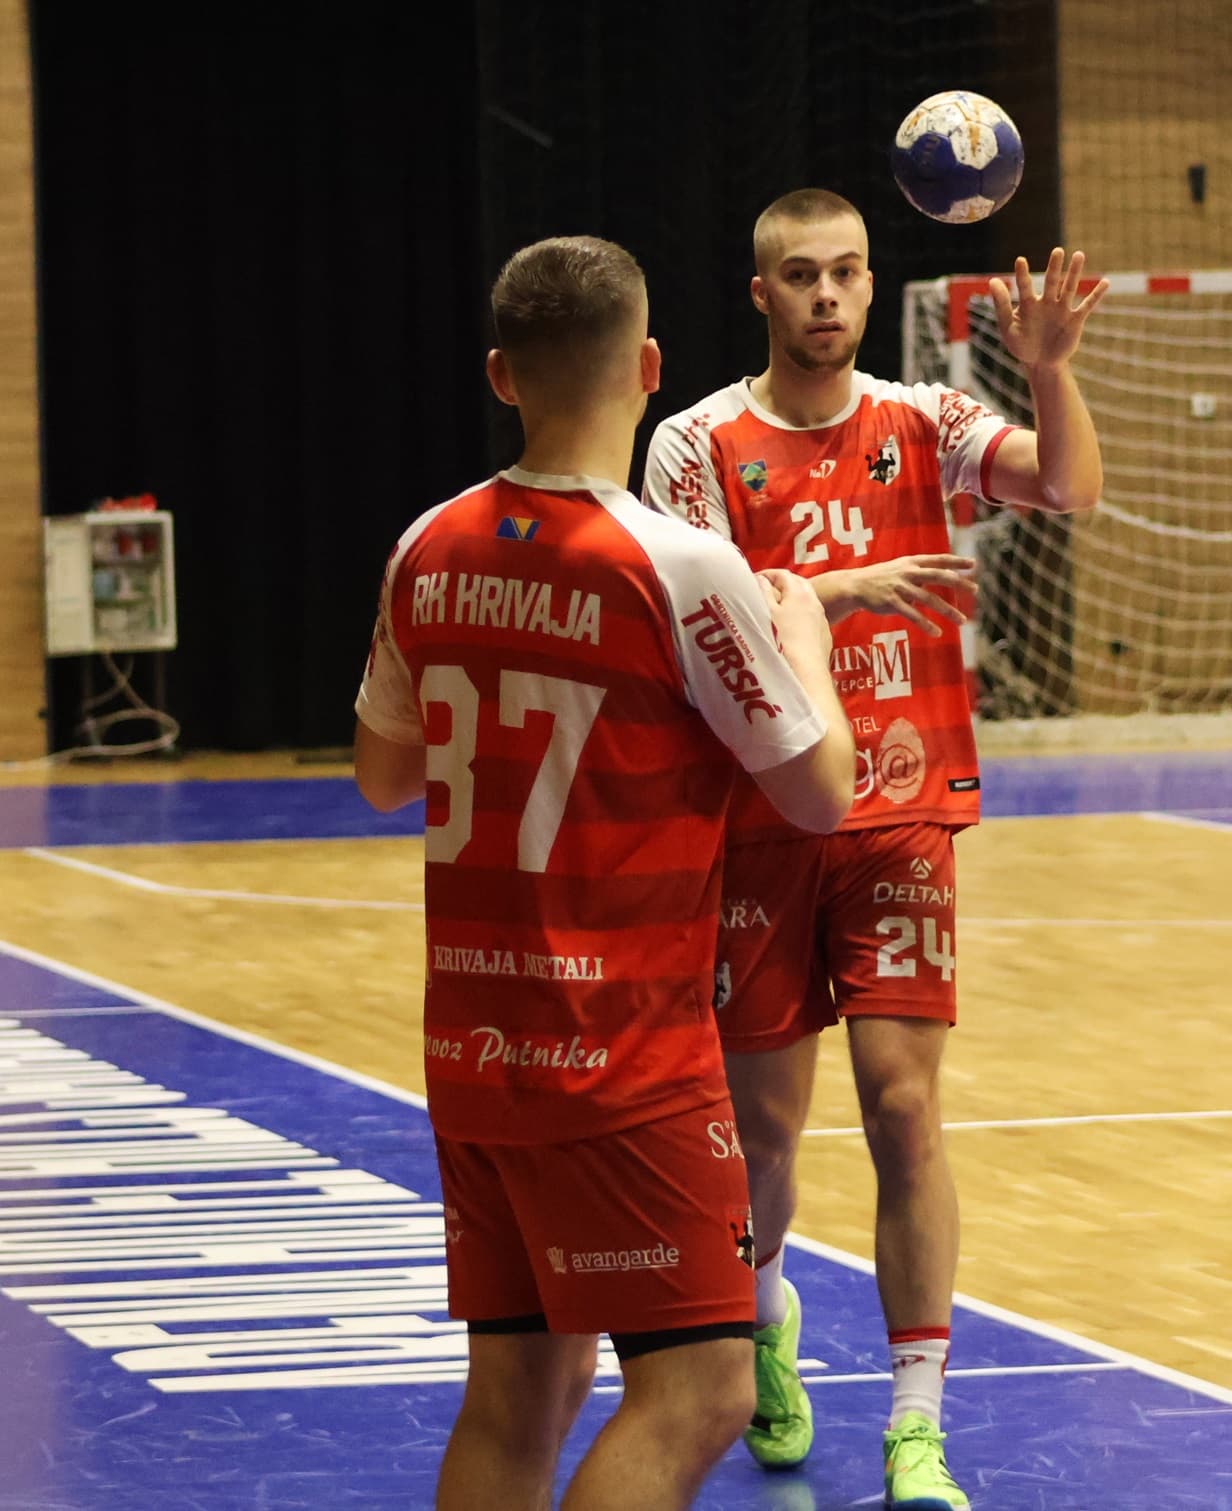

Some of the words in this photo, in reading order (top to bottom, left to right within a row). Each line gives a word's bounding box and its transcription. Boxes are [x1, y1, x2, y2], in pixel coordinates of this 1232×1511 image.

[790, 499, 874, 565] 24
[412, 571, 449, 627] RK
[455, 572, 601, 646] KRIVAJA
[419, 664, 608, 874] 37
[433, 945, 518, 975] KRIVAJA
[522, 952, 604, 981] METALI
[875, 915, 955, 982] 24
[470, 1026, 609, 1073] Putnika
[571, 1242, 680, 1272] avangarde
